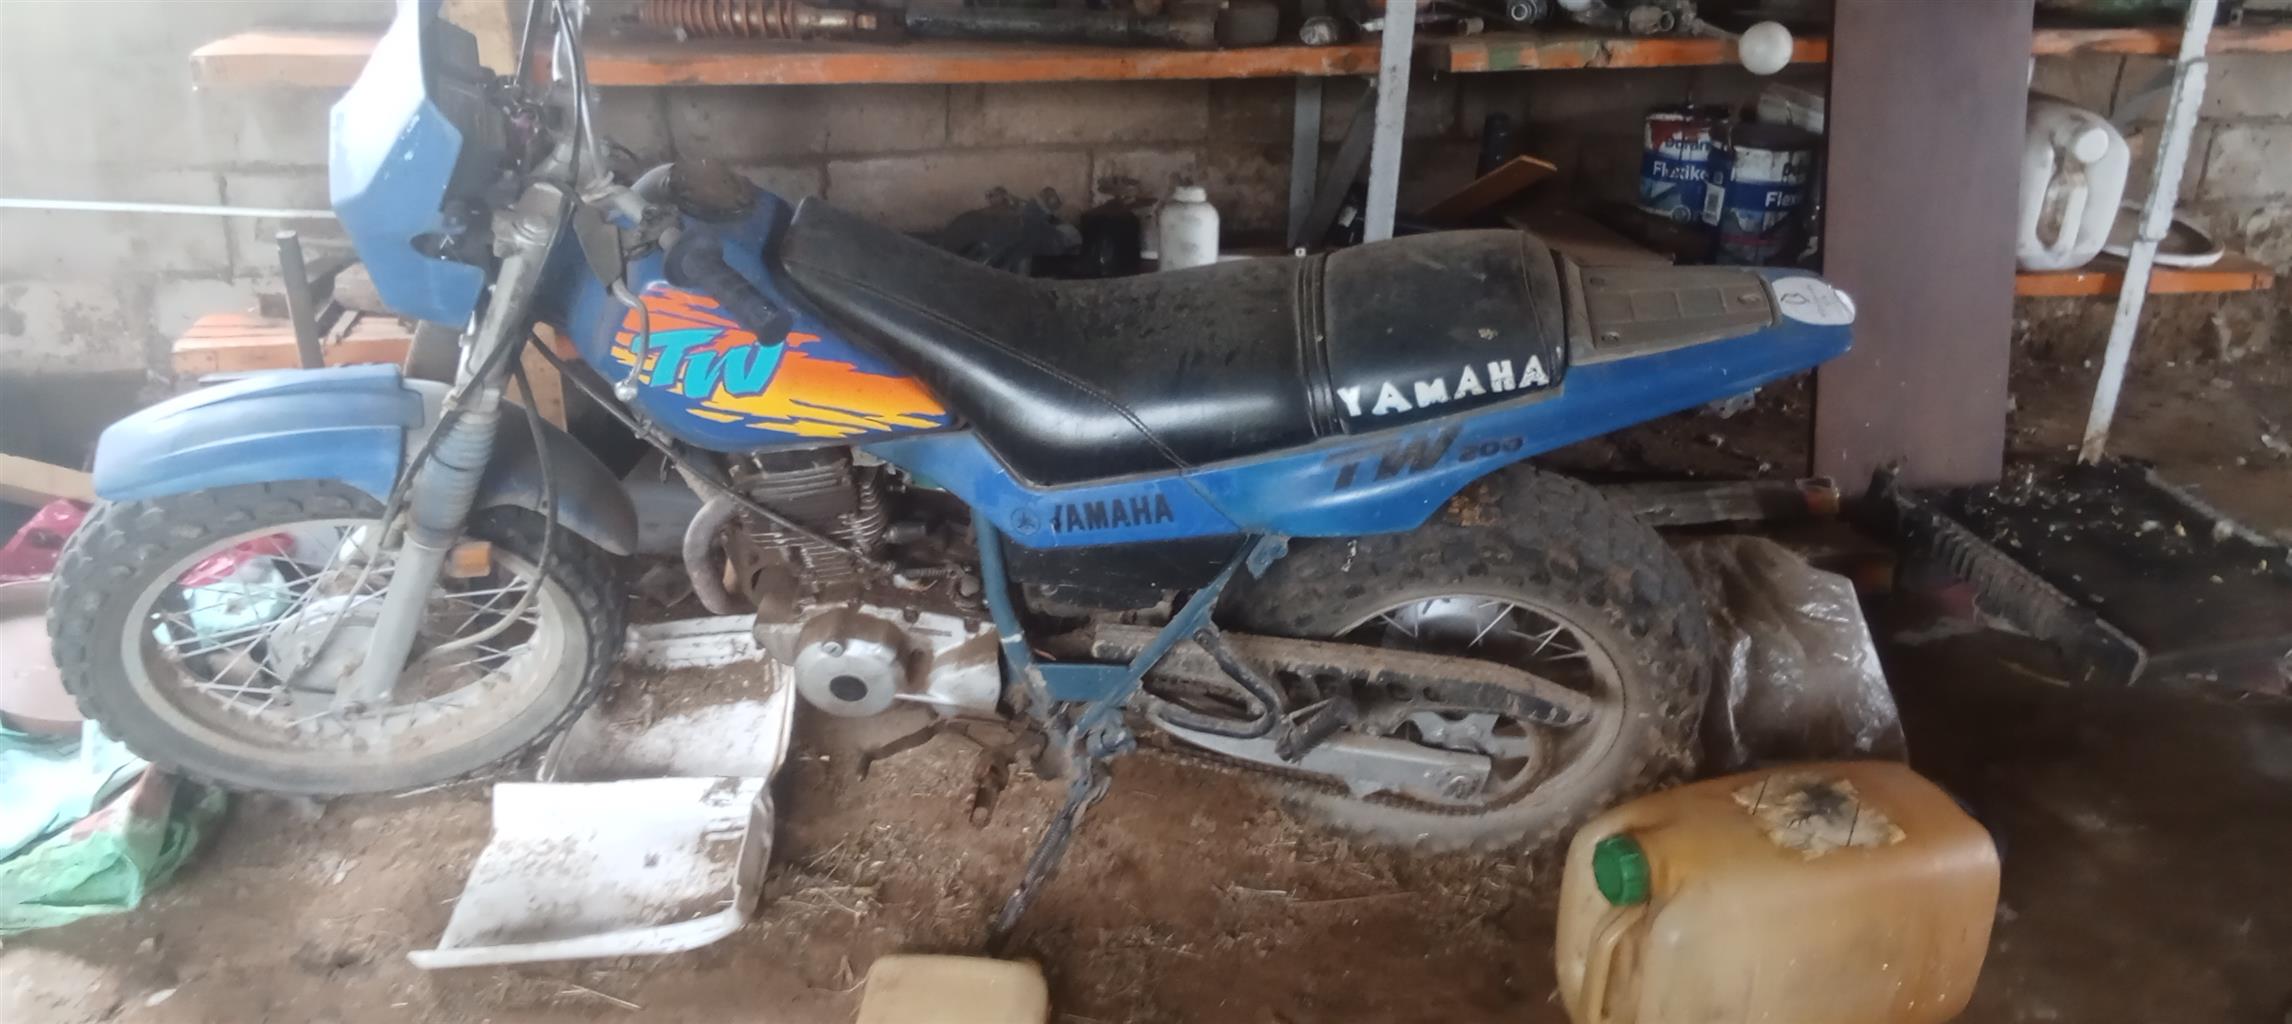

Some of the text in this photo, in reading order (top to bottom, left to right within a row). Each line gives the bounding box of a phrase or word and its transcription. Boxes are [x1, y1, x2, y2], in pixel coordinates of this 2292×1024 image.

[631, 327, 784, 399] TW
[1337, 354, 1550, 417] YAMAHA
[1321, 424, 1463, 492] TW
[1050, 493, 1174, 533] YAMAHA
